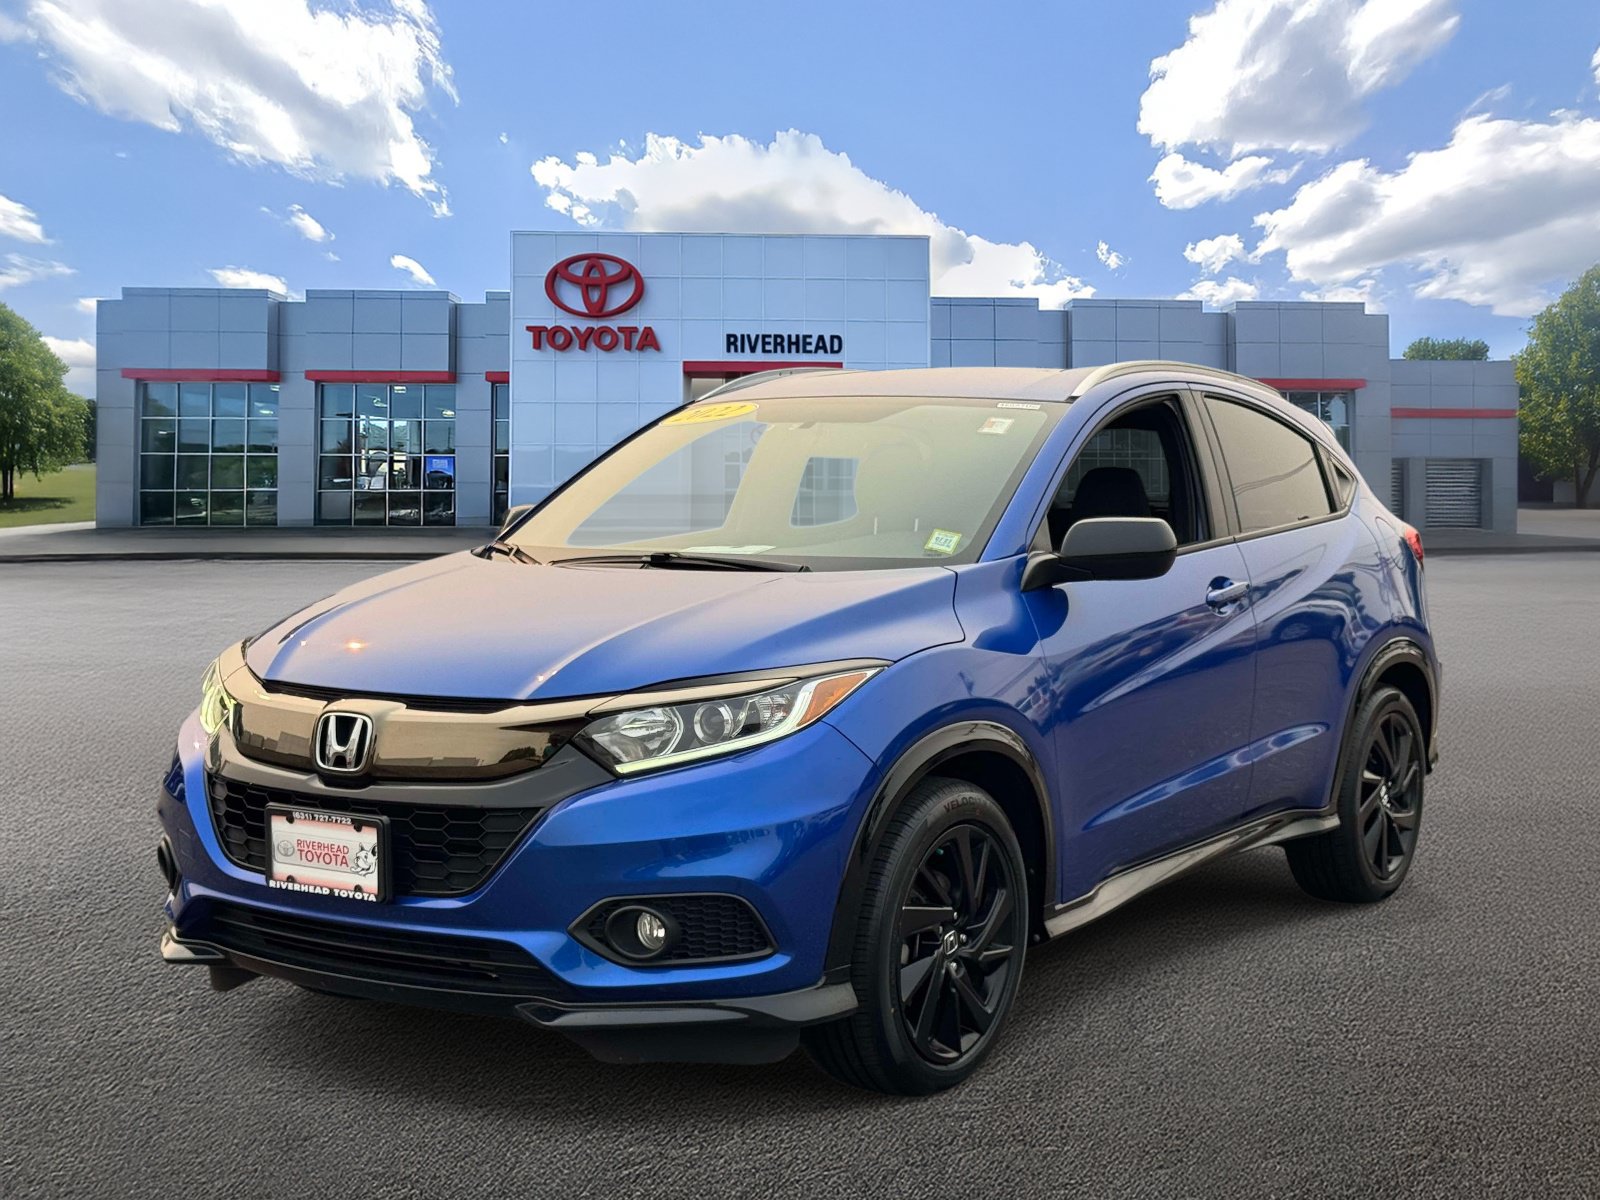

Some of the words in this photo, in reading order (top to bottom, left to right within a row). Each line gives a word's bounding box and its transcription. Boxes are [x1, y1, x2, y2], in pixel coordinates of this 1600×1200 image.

[526, 326, 661, 351] TOYOTA
[726, 334, 843, 354] RIVERHEAD
[292, 811, 312, 821] (631)
[313, 814, 352, 825] 727-7722
[296, 839, 350, 854] RIVERHEAD
[297, 849, 349, 867] TOYOTA
[268, 880, 330, 895] RIVERHEAD
[333, 888, 377, 902] TOYOTA
